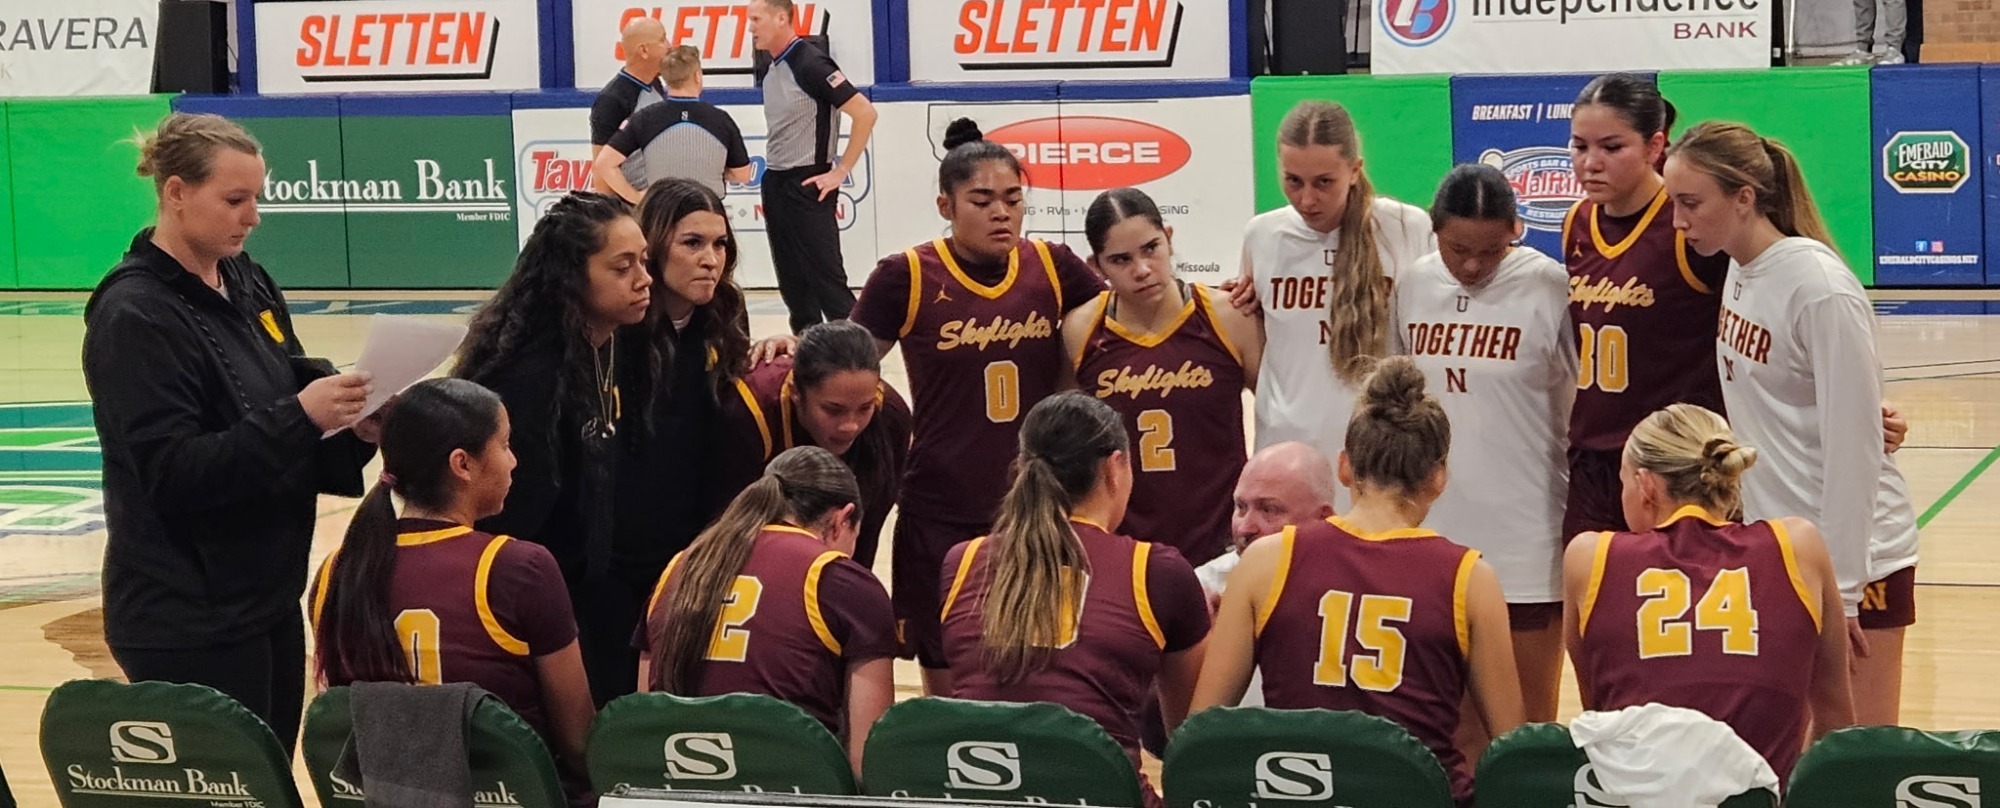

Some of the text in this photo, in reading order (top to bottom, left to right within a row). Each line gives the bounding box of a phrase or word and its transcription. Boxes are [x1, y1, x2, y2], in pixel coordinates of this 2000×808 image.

[0, 17, 149, 51] AVERA
[297, 12, 486, 67] SLETTEN
[615, 4, 815, 61] SETTN
[954, 0, 1167, 54] SLETTEN
[1674, 21, 1757, 39] BANK
[1472, 104, 1575, 120] BREAKFAST LUNC
[1003, 141, 1161, 164] PIERCE
[1899, 141, 1953, 168] EMERALD
[1910, 160, 1949, 169] CITY
[264, 158, 507, 200] tockman Bank
[1893, 171, 1960, 182] CASINO
[456, 213, 511, 221] Member FDIC
[1176, 262, 1220, 273] Missoula
[1568, 274, 1655, 313] Skylights
[937, 310, 1051, 350] Skylights
[1408, 323, 1521, 361] TOGETHER
[1717, 305, 1772, 365] GETHER
[984, 360, 1020, 423] 0
[1095, 360, 1214, 399] Skylights
[1445, 368, 1467, 393] N
[1136, 409, 1176, 472] 2
[1636, 566, 1759, 659] 24
[1313, 589, 1412, 692] 15
[67, 764, 250, 796] Stockman Bank
[474, 781, 519, 804] ank
